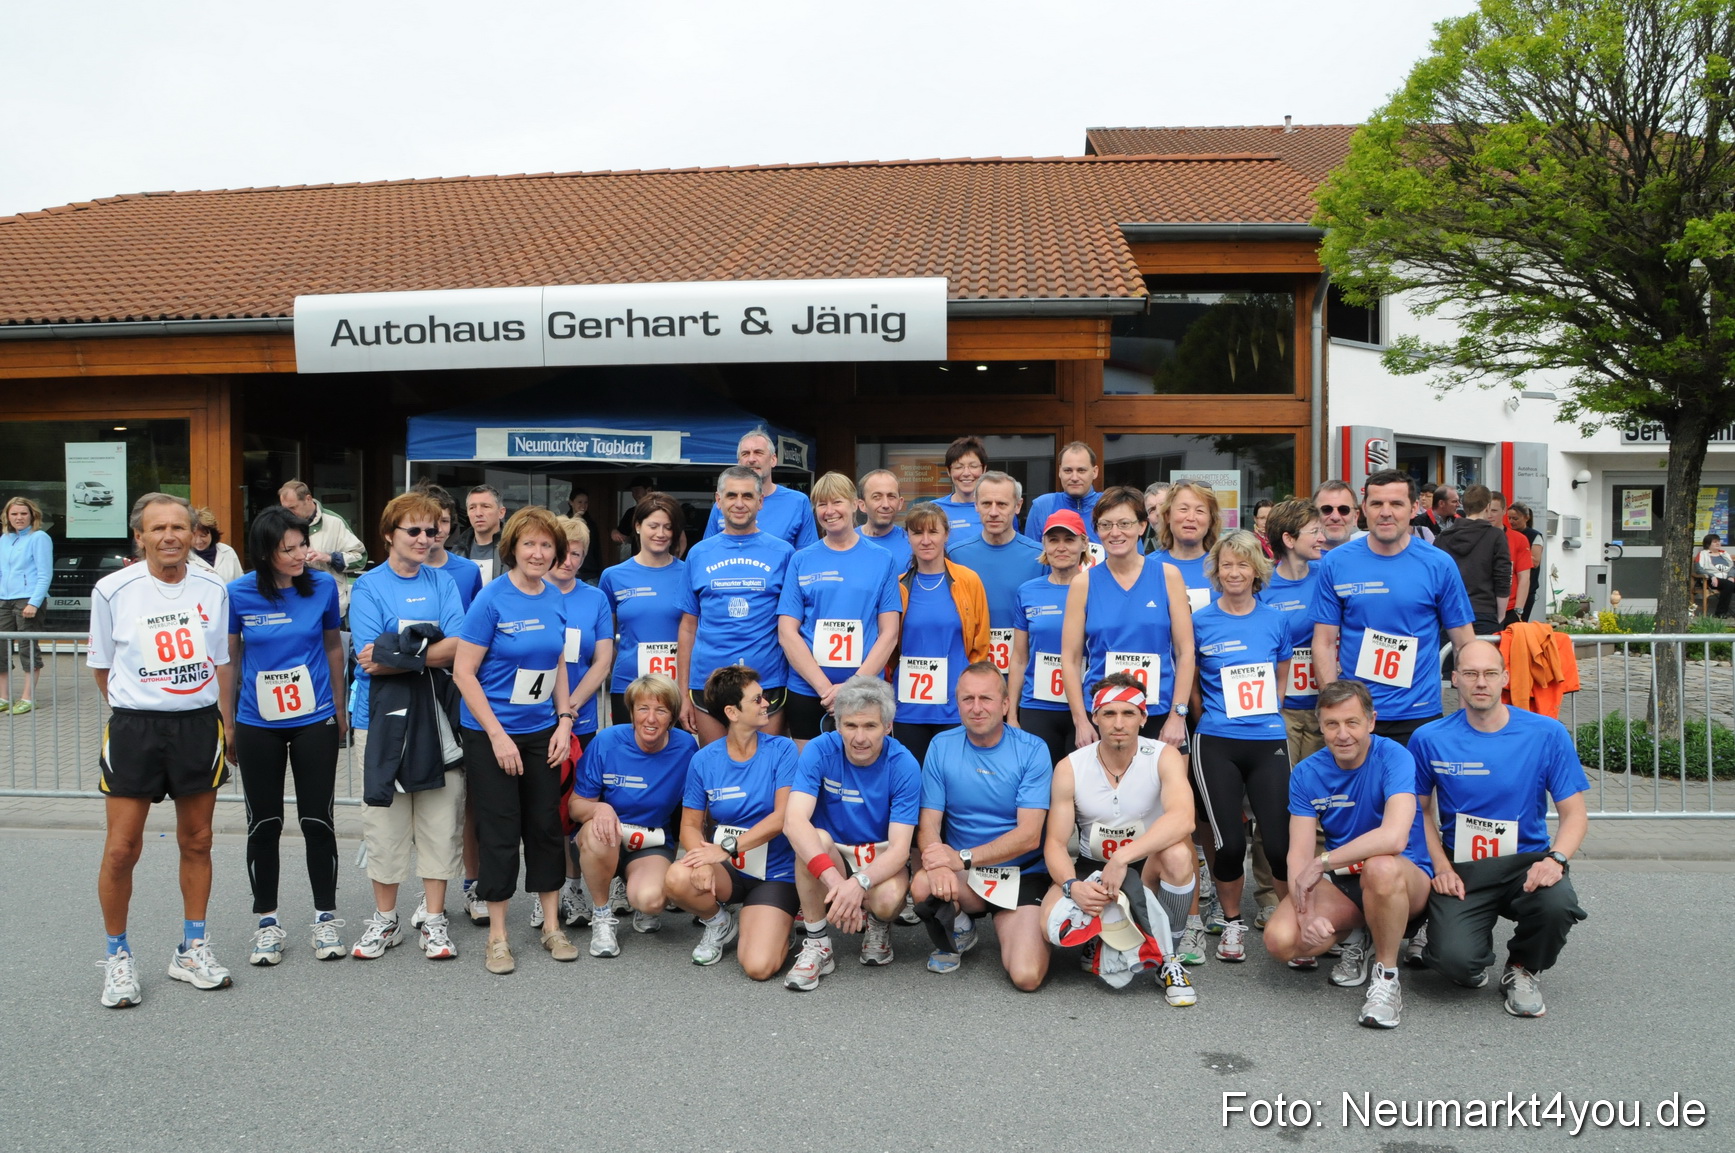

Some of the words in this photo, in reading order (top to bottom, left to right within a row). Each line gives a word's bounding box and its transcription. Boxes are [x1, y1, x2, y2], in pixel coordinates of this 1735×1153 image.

[330, 315, 526, 347] Autohaus
[547, 308, 722, 340] Gerhart
[740, 306, 774, 336] &
[791, 303, 907, 343] Jänig
[514, 436, 589, 453] Neumarkter
[590, 437, 646, 456] Tagblatt
[705, 557, 772, 574] funrunners
[742, 579, 762, 587] Tagblatt
[147, 613, 177, 625] MEYER
[148, 620, 178, 630] WERBUNG
[154, 627, 195, 663] 86
[828, 633, 852, 661] 21
[1372, 633, 1398, 645] MEYER
[1372, 640, 1398, 649] WERBUNG
[1043, 655, 1062, 663] MEYE
[1115, 654, 1140, 662] MEYER
[1373, 648, 1401, 680] 16
[264, 673, 289, 681] MEYER
[649, 656, 677, 681] 65
[1230, 667, 1255, 675] MEYER
[528, 673, 545, 700] 4
[909, 672, 933, 700] 72
[1238, 679, 1265, 710] 67
[272, 684, 302, 713] 13
[1099, 826, 1125, 835] MEYER
[1466, 817, 1493, 828] MEYER
[1466, 824, 1493, 833] WERBUNG
[627, 831, 645, 851] 9
[1471, 834, 1499, 862] 61
[976, 866, 999, 875] MEYER
[983, 880, 998, 898] 7
